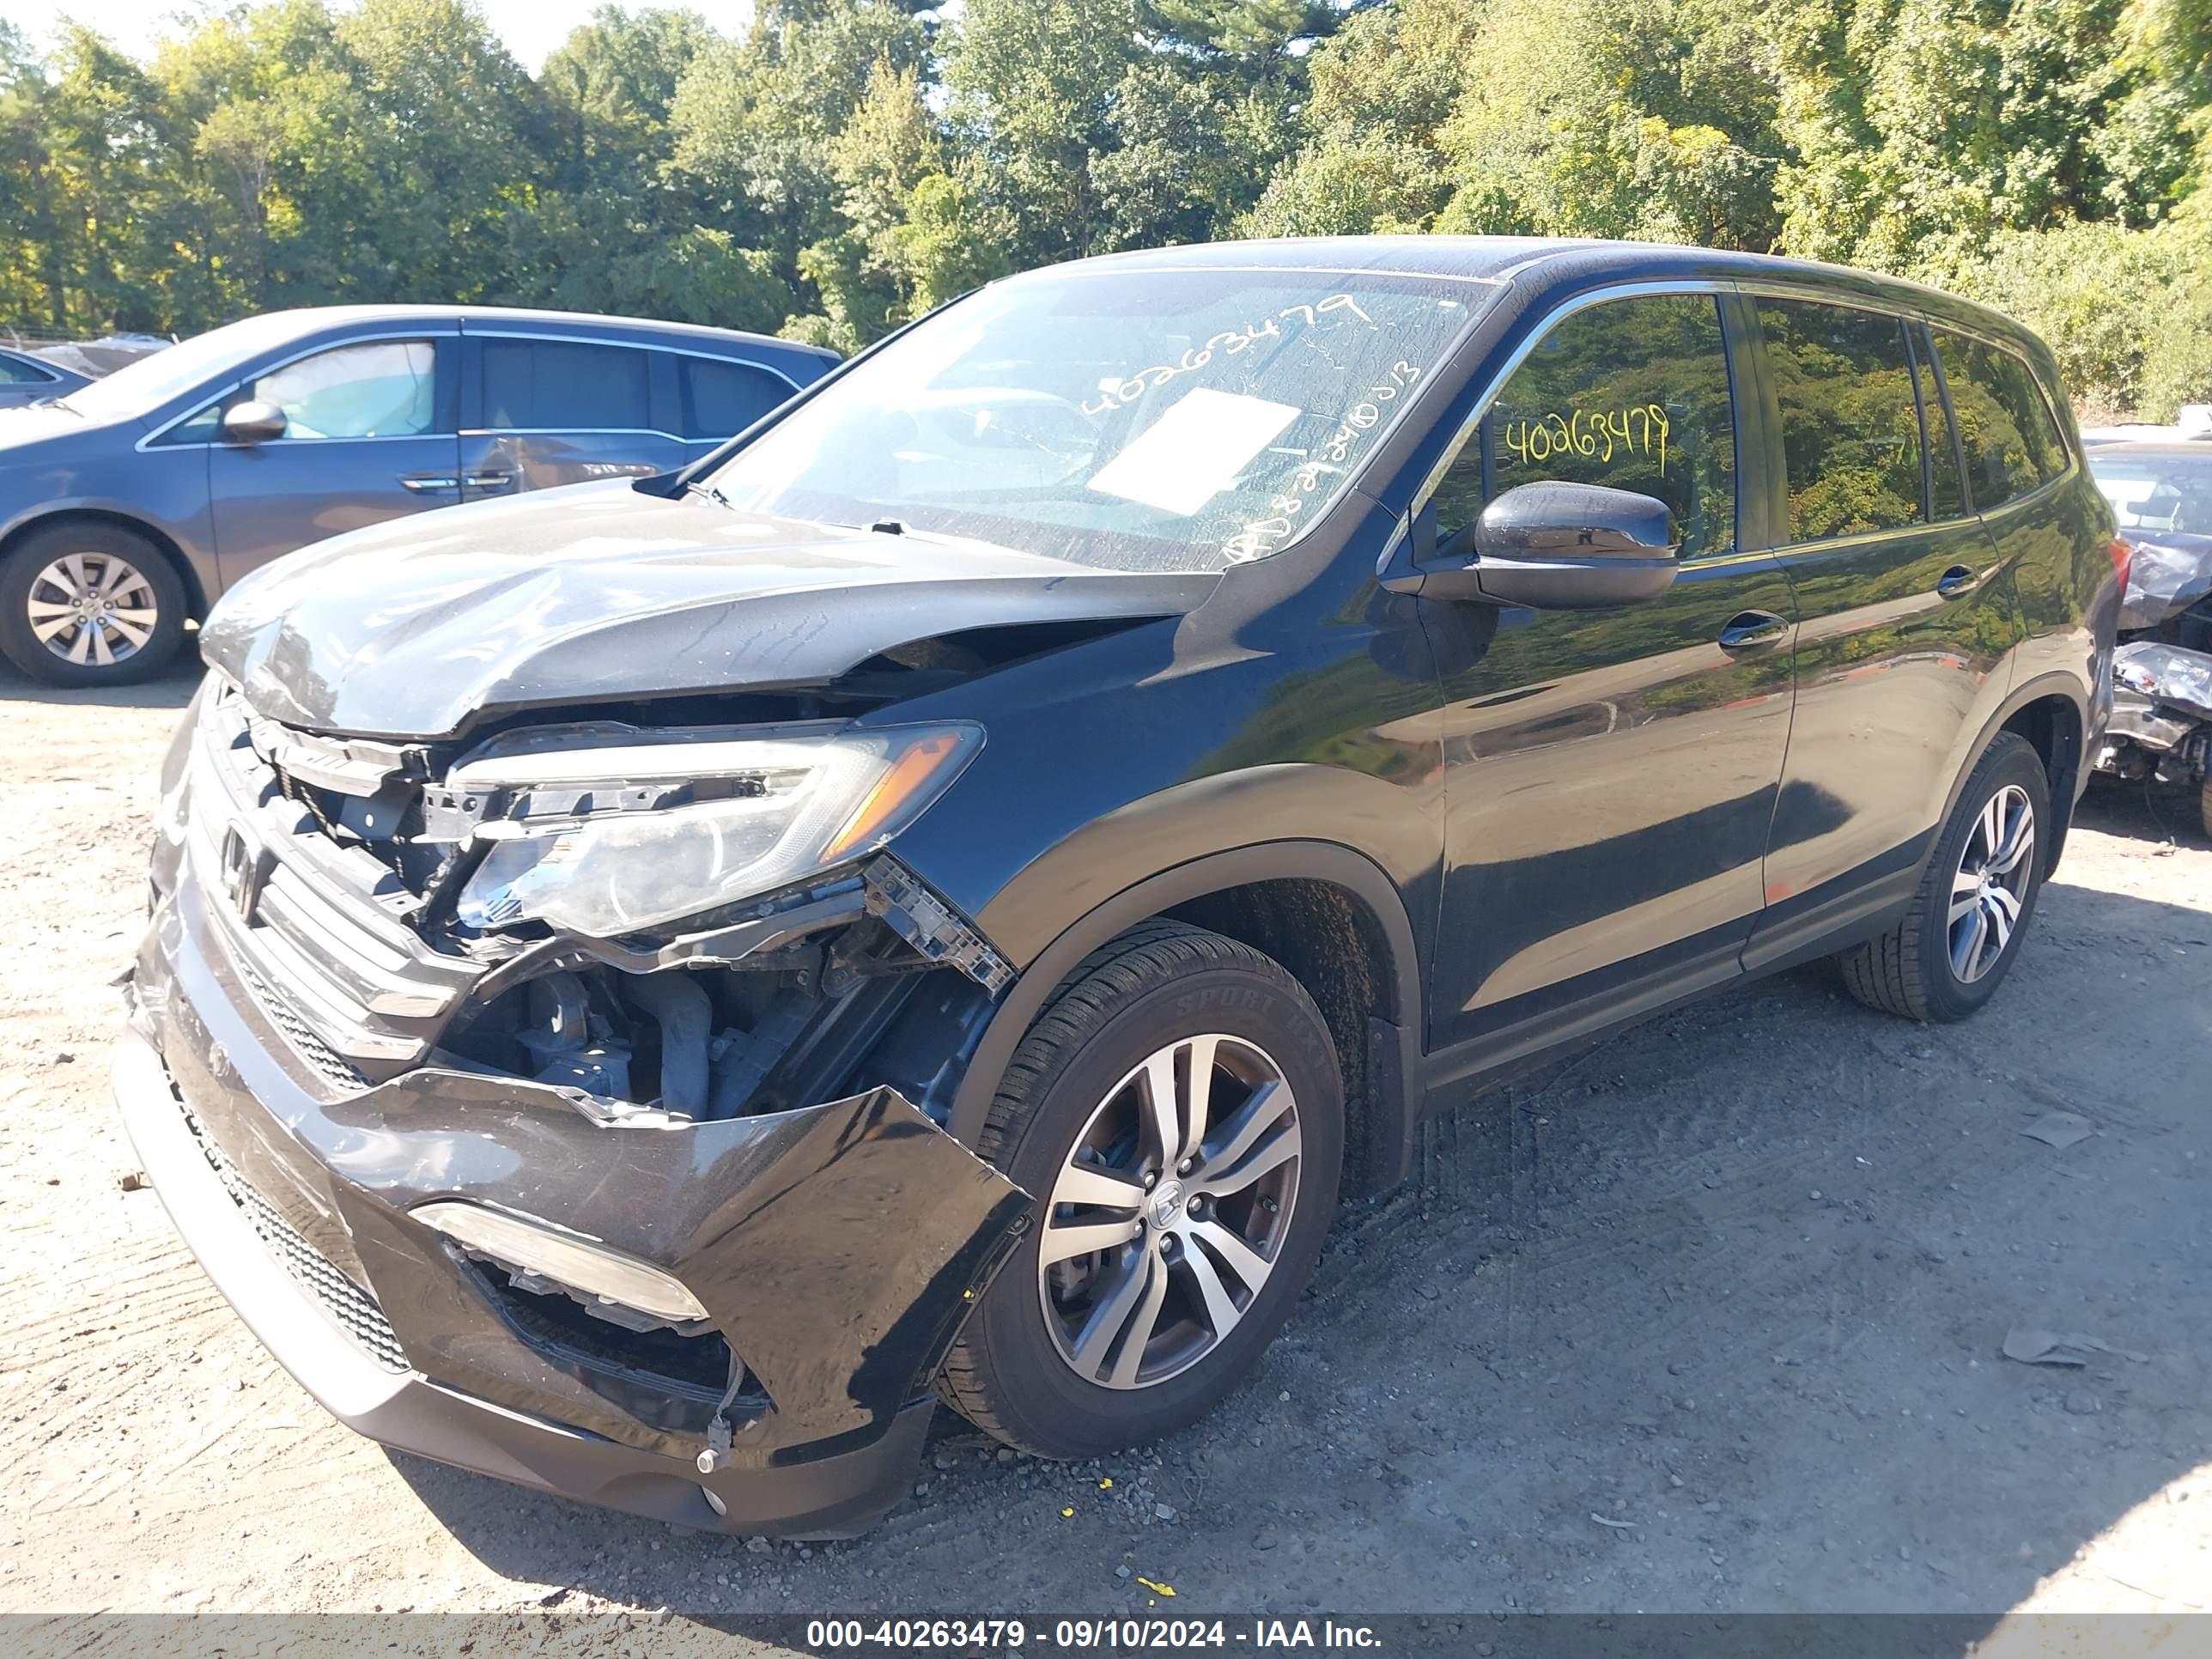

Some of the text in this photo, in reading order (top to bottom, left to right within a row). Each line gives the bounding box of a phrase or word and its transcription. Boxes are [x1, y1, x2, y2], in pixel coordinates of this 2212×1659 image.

[1081, 294, 1373, 416] 40263479
[1506, 404, 1669, 478] 40263479
[1176, 987, 1278, 1018] SPORT
